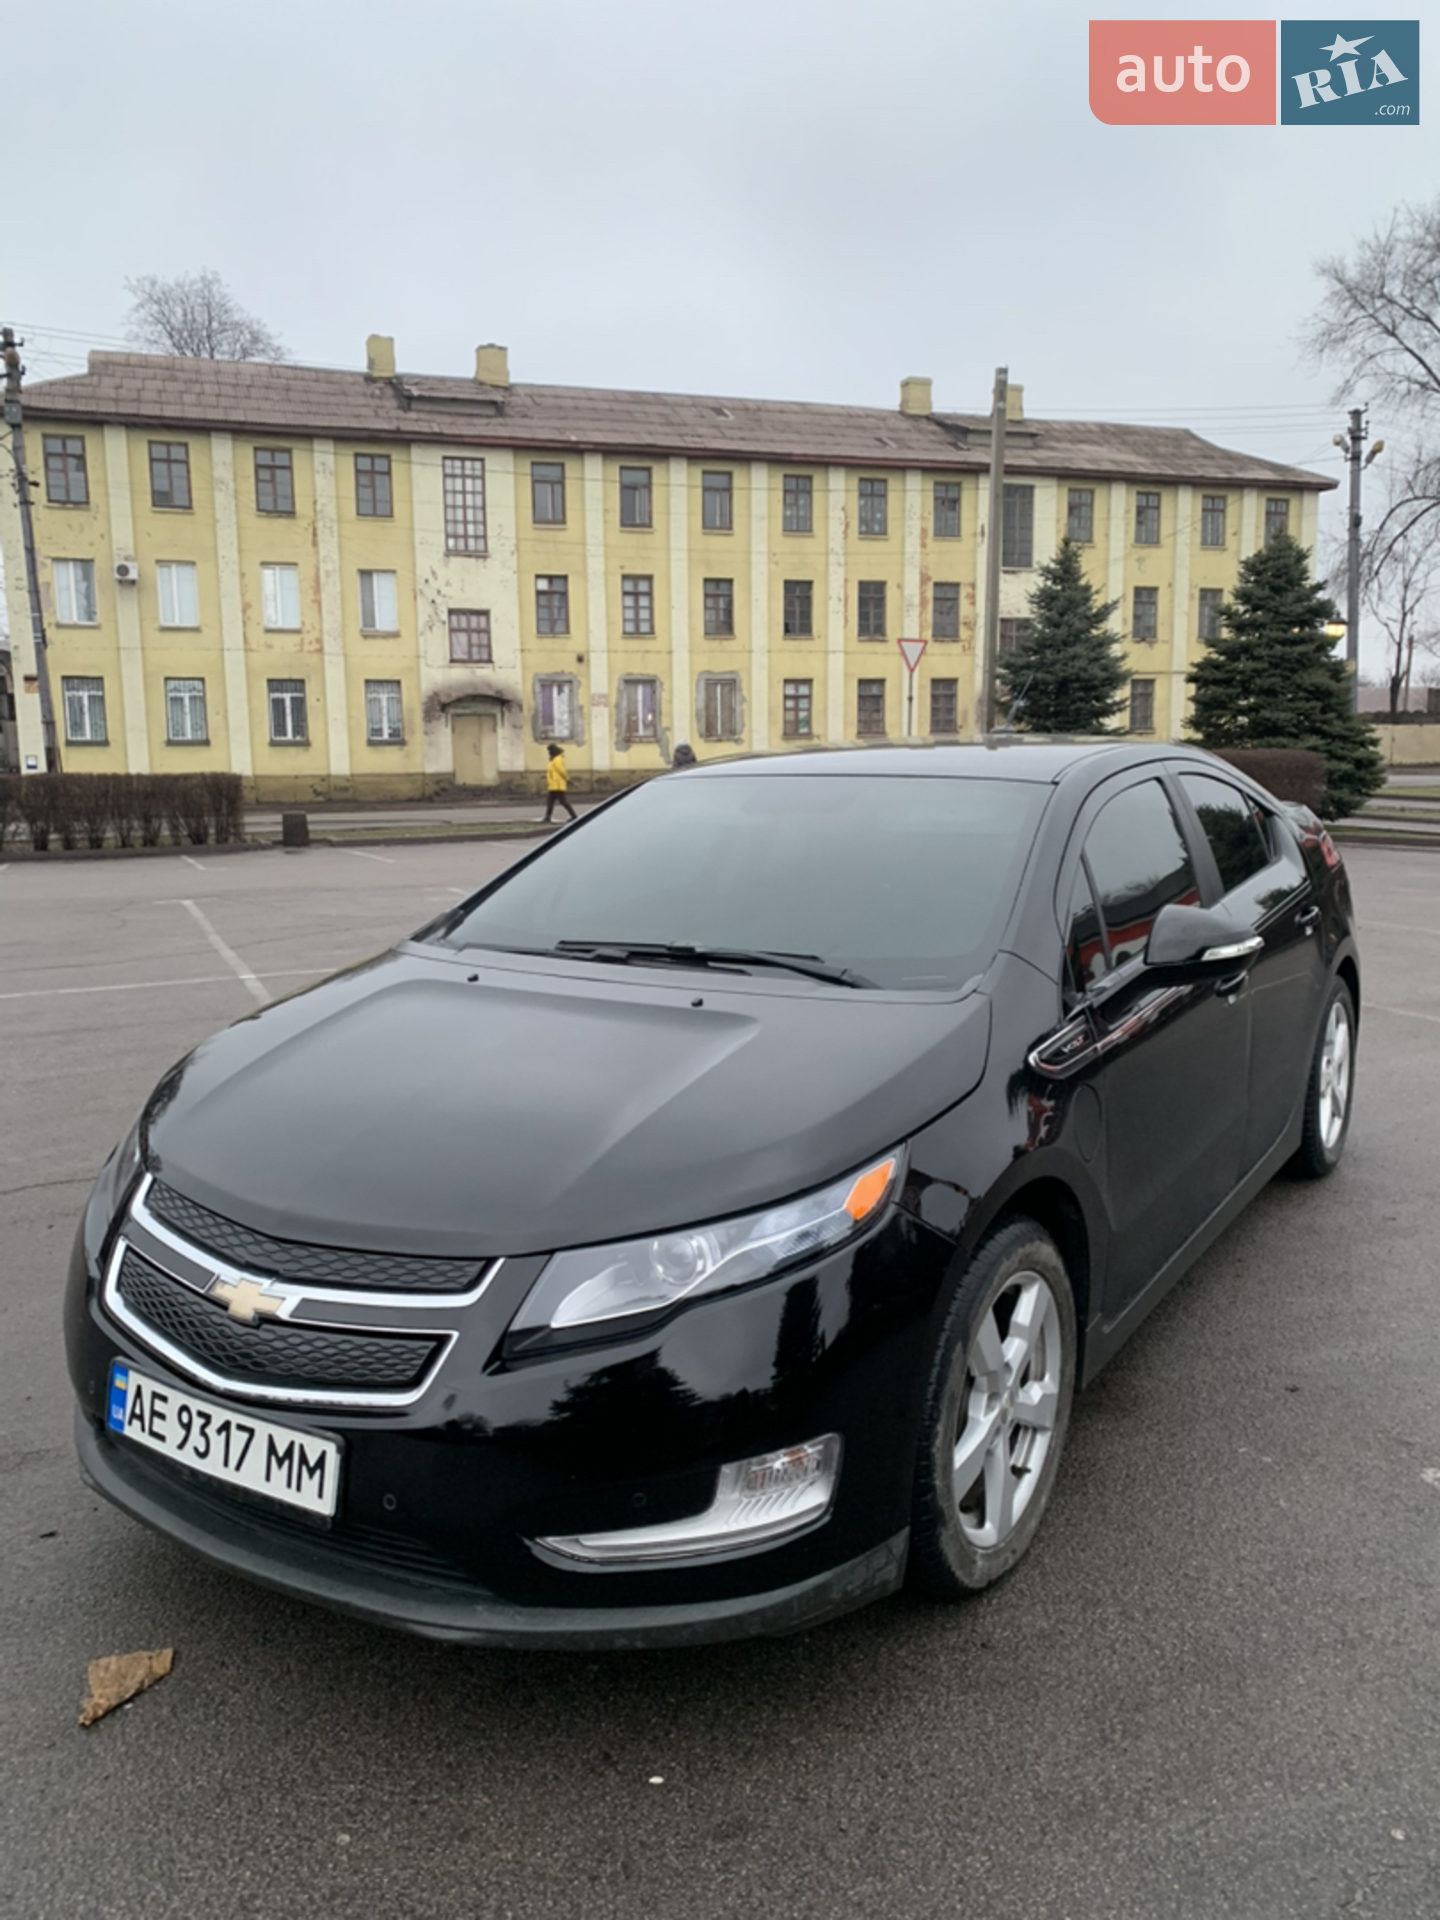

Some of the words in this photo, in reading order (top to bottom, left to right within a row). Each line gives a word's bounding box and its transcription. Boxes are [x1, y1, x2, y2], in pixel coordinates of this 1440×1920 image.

[127, 1383, 169, 1443] AE
[176, 1403, 256, 1473] 9317
[264, 1432, 327, 1500] MM
